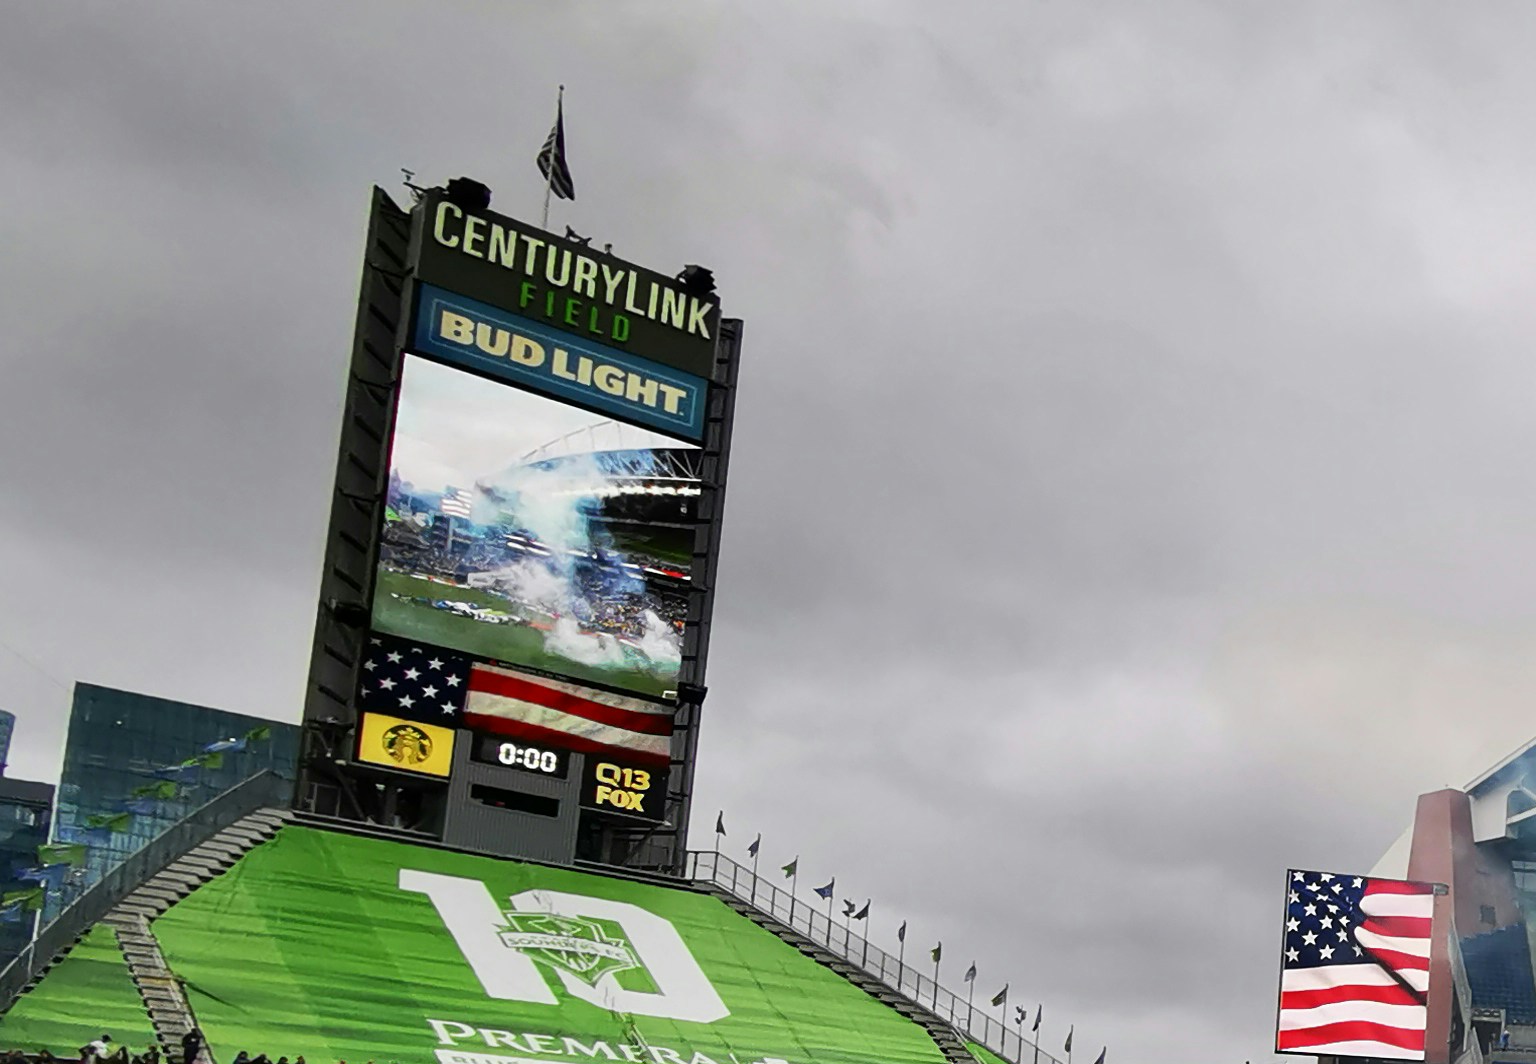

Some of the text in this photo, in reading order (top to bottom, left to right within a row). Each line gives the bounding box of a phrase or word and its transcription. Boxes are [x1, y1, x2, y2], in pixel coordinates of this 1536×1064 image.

[433, 200, 714, 340] CENTURYLINK
[519, 281, 631, 342] FIELD
[439, 309, 688, 415] BUD LIGHT
[498, 741, 558, 773] 0:00
[596, 763, 651, 791] Q13
[596, 785, 645, 813] FOX
[398, 868, 732, 1024] 10
